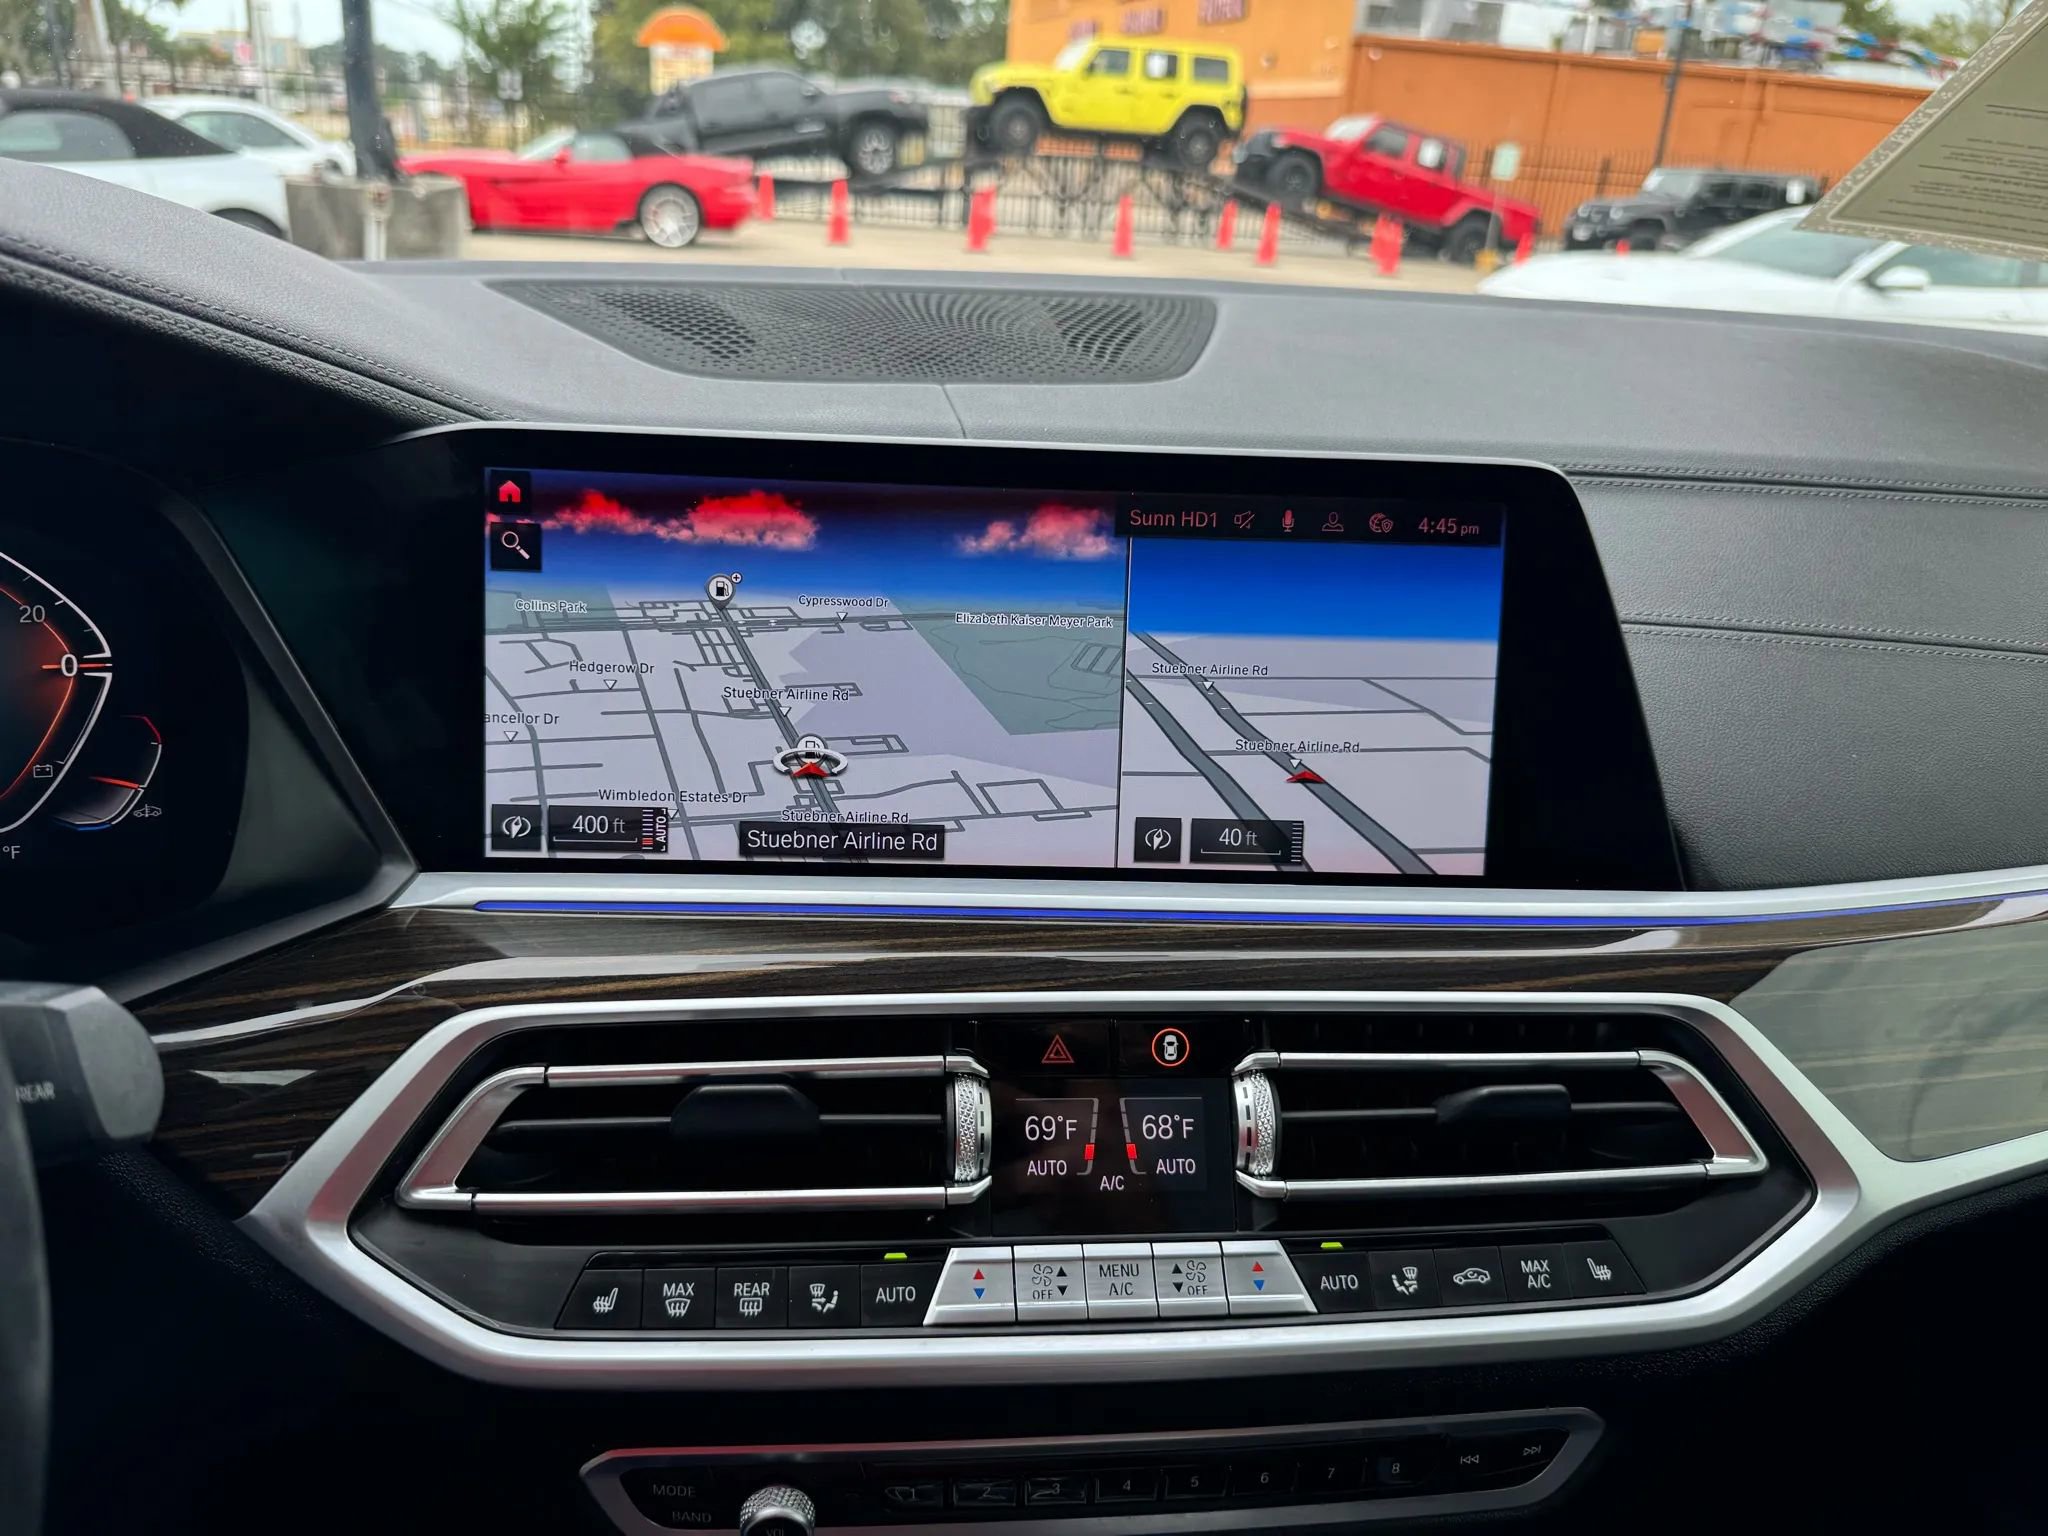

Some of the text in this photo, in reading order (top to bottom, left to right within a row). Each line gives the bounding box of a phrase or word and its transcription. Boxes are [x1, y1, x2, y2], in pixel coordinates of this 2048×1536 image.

[1130, 509, 1217, 528] Sunn HD1
[1418, 517, 1480, 537] 4:45 pm
[515, 600, 587, 613] Collins Park
[798, 595, 888, 609] Cypresswood Dr
[19, 605, 46, 623] 20
[955, 612, 1113, 629] Elizabeth Kaiser Meyer Park
[60, 653, 78, 677] 0
[569, 660, 655, 674] Hedgerow Dr
[1152, 662, 1268, 676] Stuebner Airline Rd
[723, 686, 849, 701] Stuebner Airline Rd
[543, 713, 559, 724] Dr
[1235, 739, 1360, 753] Stuebner Airline Rd
[599, 789, 748, 803] Wimbledon Estates Dr
[782, 809, 909, 823] Stuebner Airline Rd
[573, 815, 625, 833] 400 ft
[656, 816, 666, 842] AUTO
[748, 829, 937, 851] Stuebner Airline Rd
[1219, 828, 1257, 846] 40 ft
[1025, 1115, 1078, 1141] 69°F
[1142, 1114, 1195, 1140] 68°F
[1027, 1160, 1067, 1176] AUTO
[1156, 1158, 1196, 1174] AUTO
[1100, 1175, 1125, 1191] A/C
[1099, 1264, 1140, 1278] MENU
[1521, 1259, 1550, 1273] MAX
[1320, 1274, 1358, 1290] AUTO
[1527, 1274, 1551, 1289] A/C
[663, 1282, 695, 1296] MAX
[734, 1282, 770, 1296] REAR
[876, 1286, 916, 1303] AUTO
[1032, 1289, 1053, 1300] OFF
[1109, 1282, 1134, 1297] A/C
[1187, 1285, 1208, 1296] OFF
[1327, 1467, 1335, 1479] 7
[1392, 1462, 1400, 1474] 8
[1191, 1476, 1199, 1487] 5
[1260, 1472, 1269, 1484] 6
[652, 1483, 697, 1497] MODE
[1051, 1483, 1060, 1494] 3
[1122, 1480, 1131, 1491] 4
[672, 1511, 712, 1524] BAND
